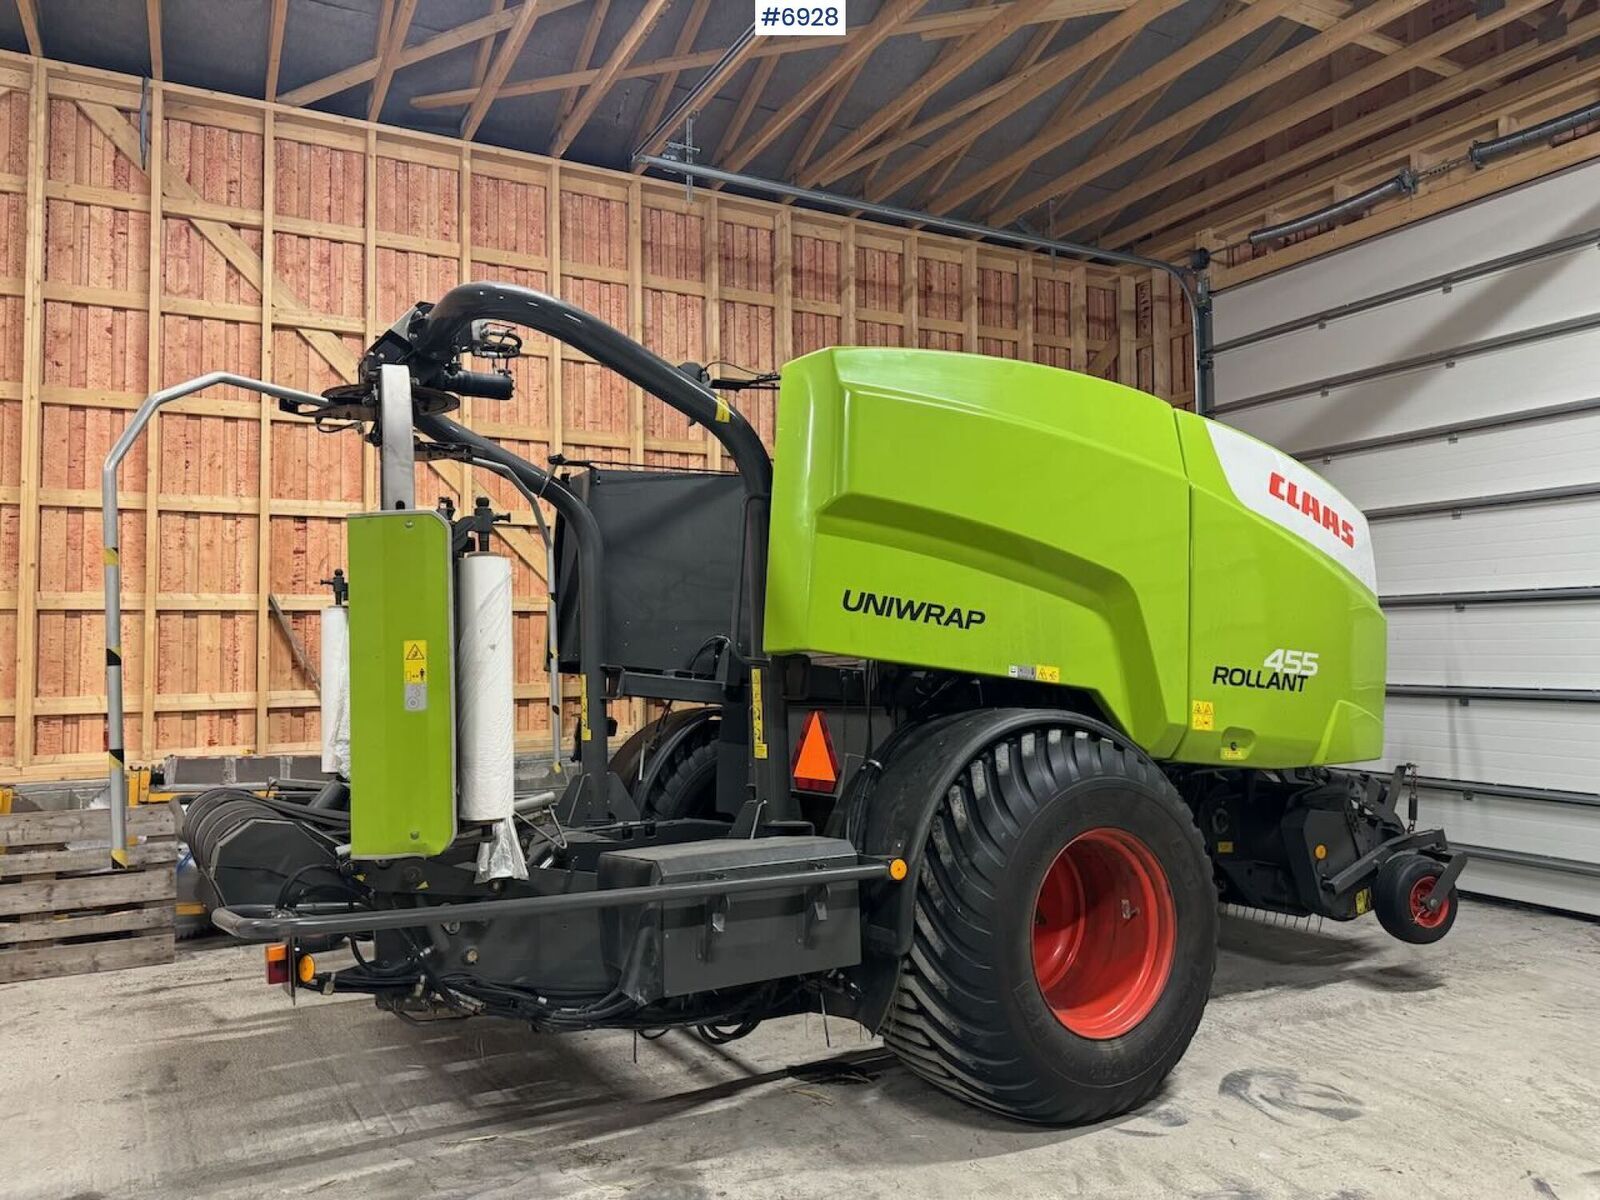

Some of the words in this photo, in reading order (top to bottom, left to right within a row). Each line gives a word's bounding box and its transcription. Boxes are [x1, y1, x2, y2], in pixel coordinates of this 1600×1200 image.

[1269, 472, 1354, 548] CLAAS
[842, 589, 986, 630] UNIWRAP
[1212, 666, 1308, 692] ROLLANT
[1263, 648, 1319, 676] 455
